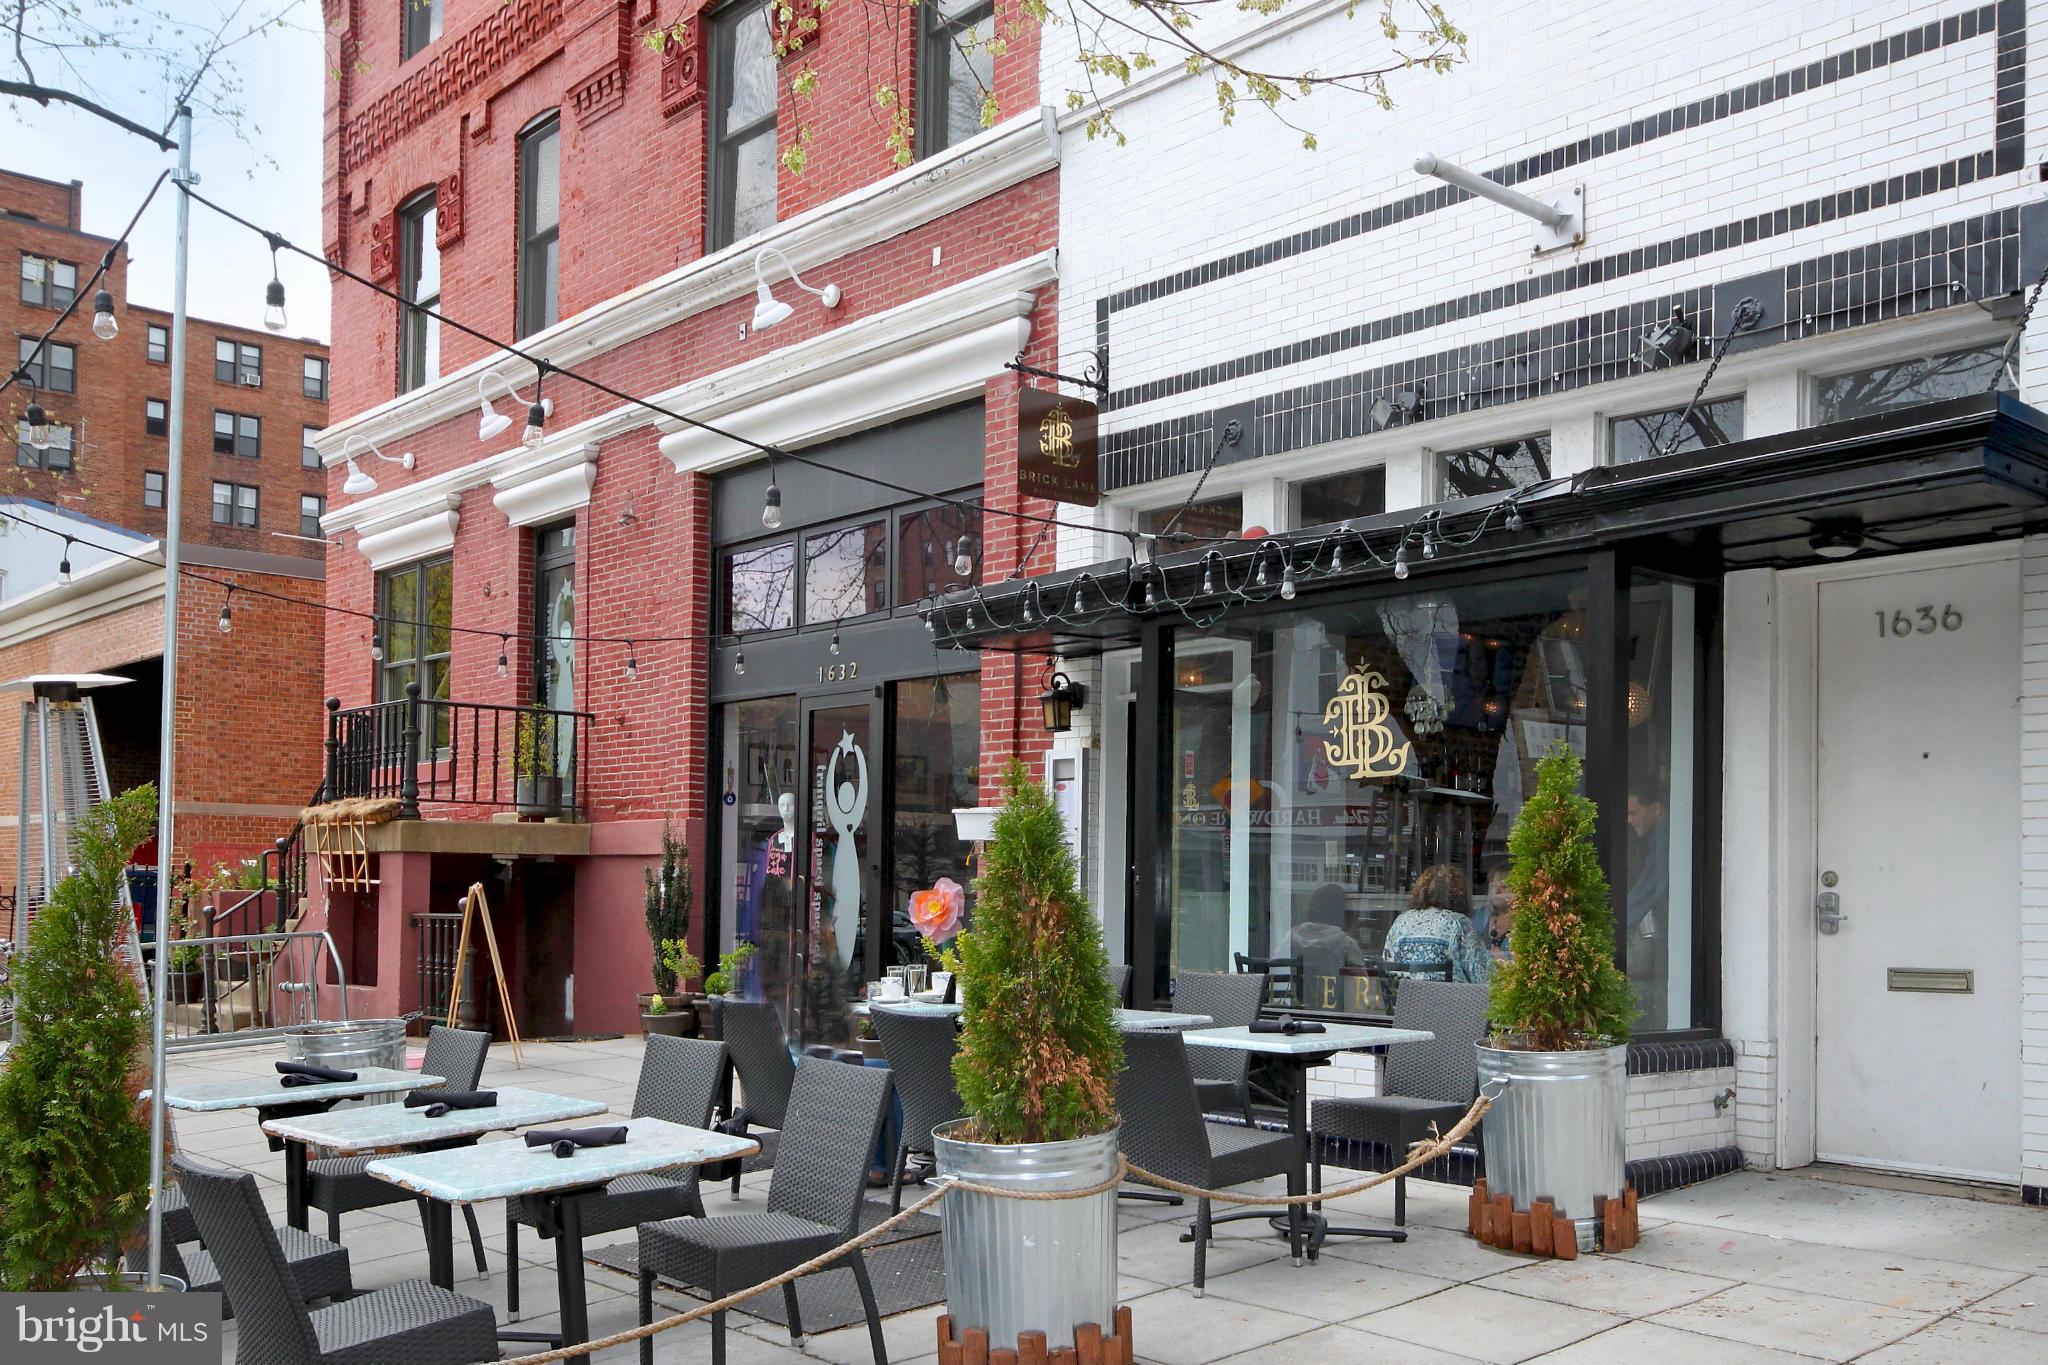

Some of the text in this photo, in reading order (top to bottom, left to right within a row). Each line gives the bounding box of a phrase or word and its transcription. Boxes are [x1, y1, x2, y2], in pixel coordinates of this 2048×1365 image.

[1019, 469, 1058, 487] BRICK
[1875, 604, 1963, 638] 1636
[819, 661, 857, 683] 1632
